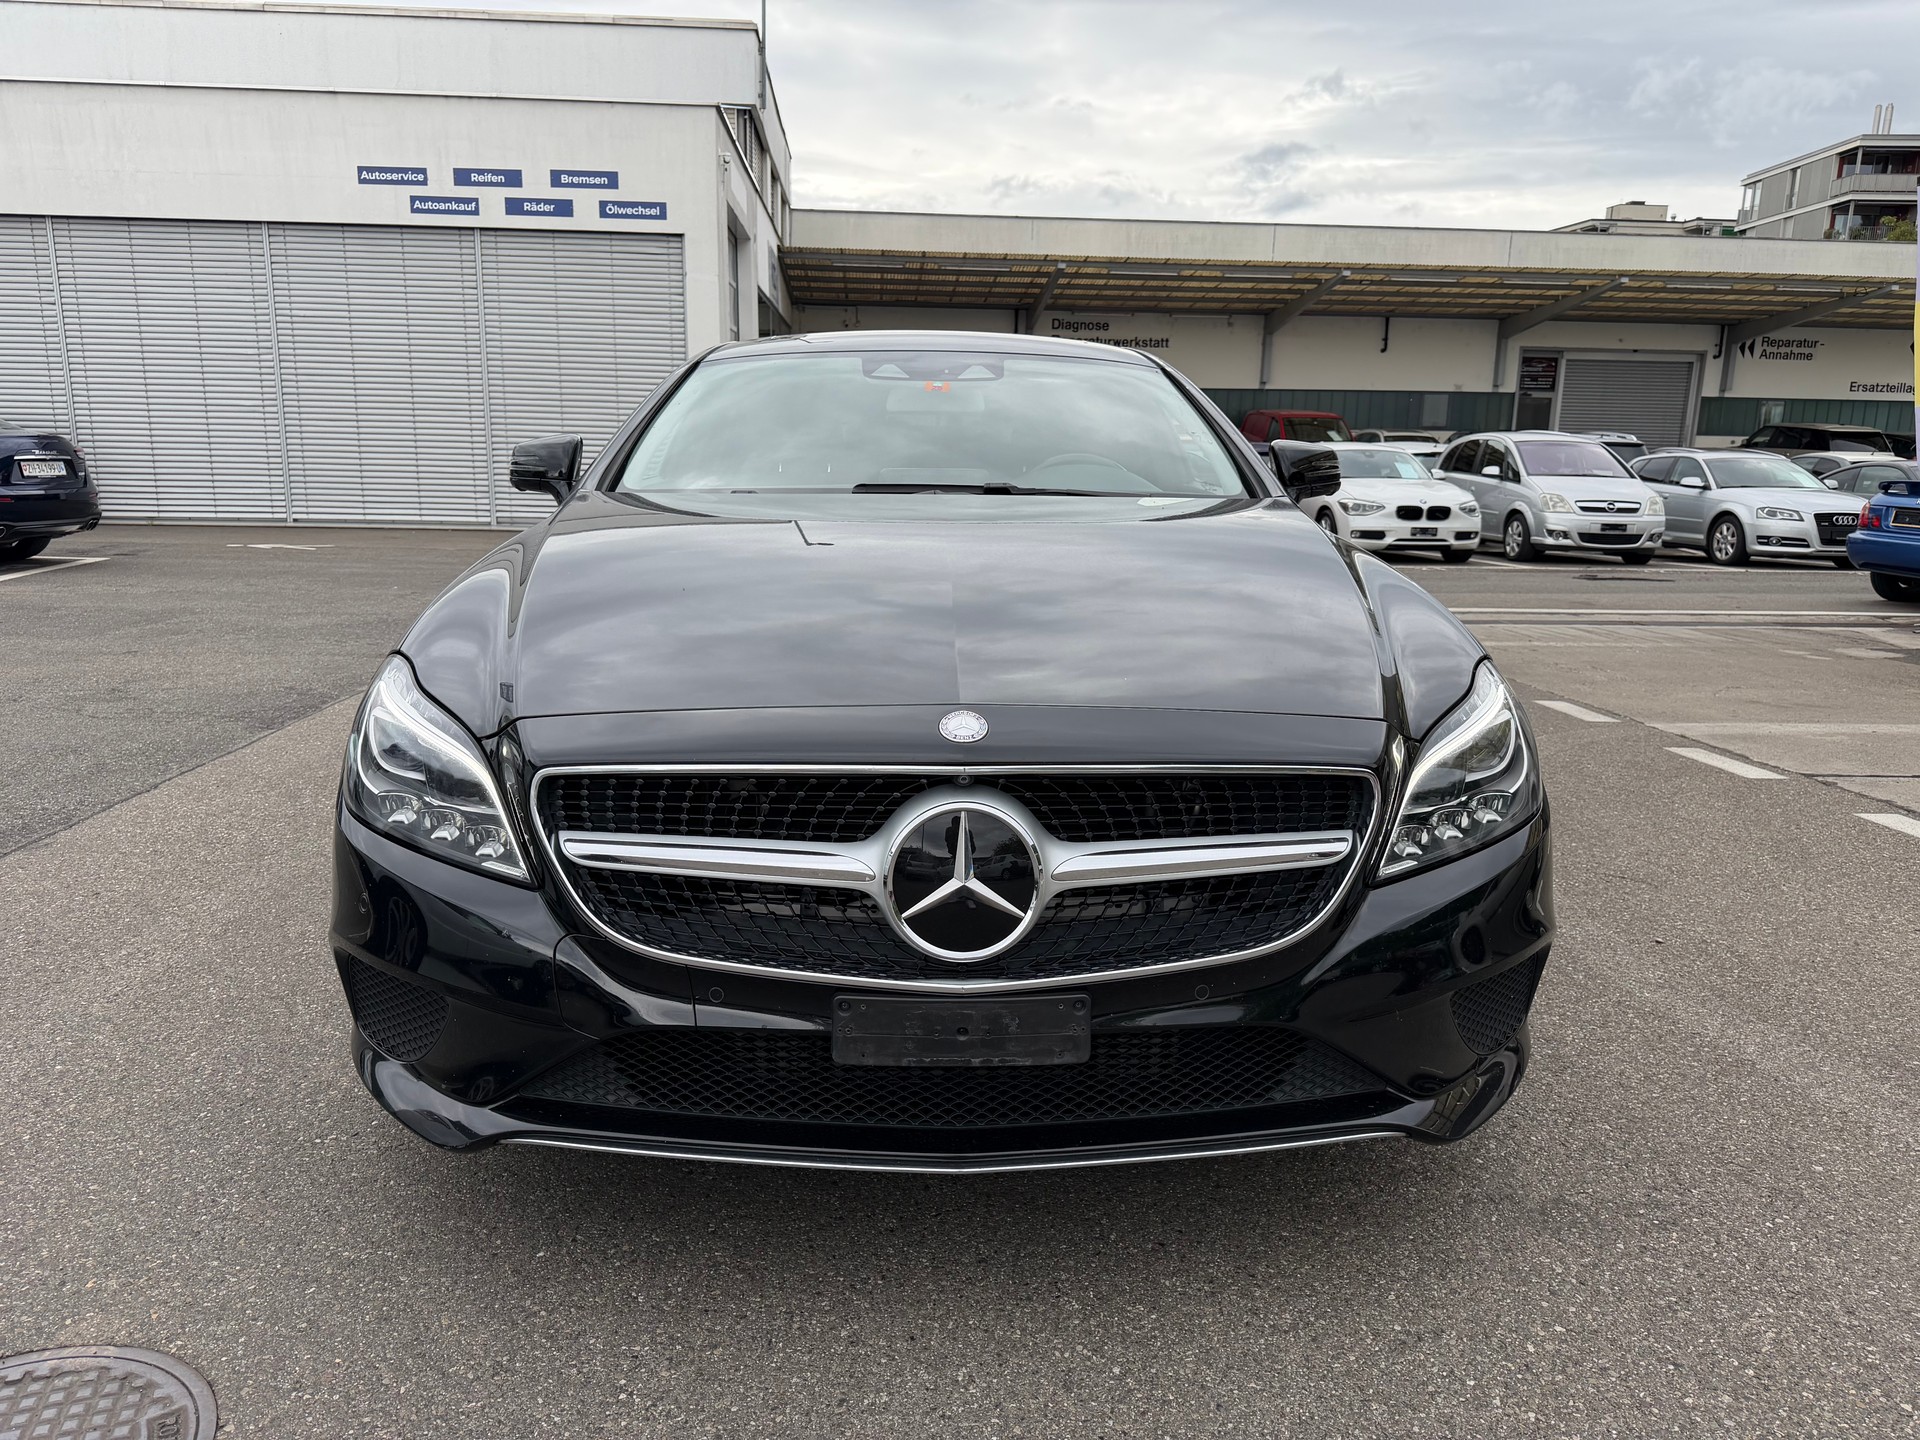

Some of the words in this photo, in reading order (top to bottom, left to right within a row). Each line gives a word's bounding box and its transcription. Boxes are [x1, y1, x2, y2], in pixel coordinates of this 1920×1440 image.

[360, 170, 425, 182] Autoservice
[470, 172, 505, 184] Reifen
[560, 174, 608, 185] Bremsen
[413, 200, 477, 212] Autoankauf
[523, 201, 555, 212] Räder
[605, 203, 660, 216] Ölwechsel
[1051, 318, 1110, 333] Diagnose
[1761, 336, 1825, 350] Reparatur-
[1759, 349, 1814, 361] Annahme
